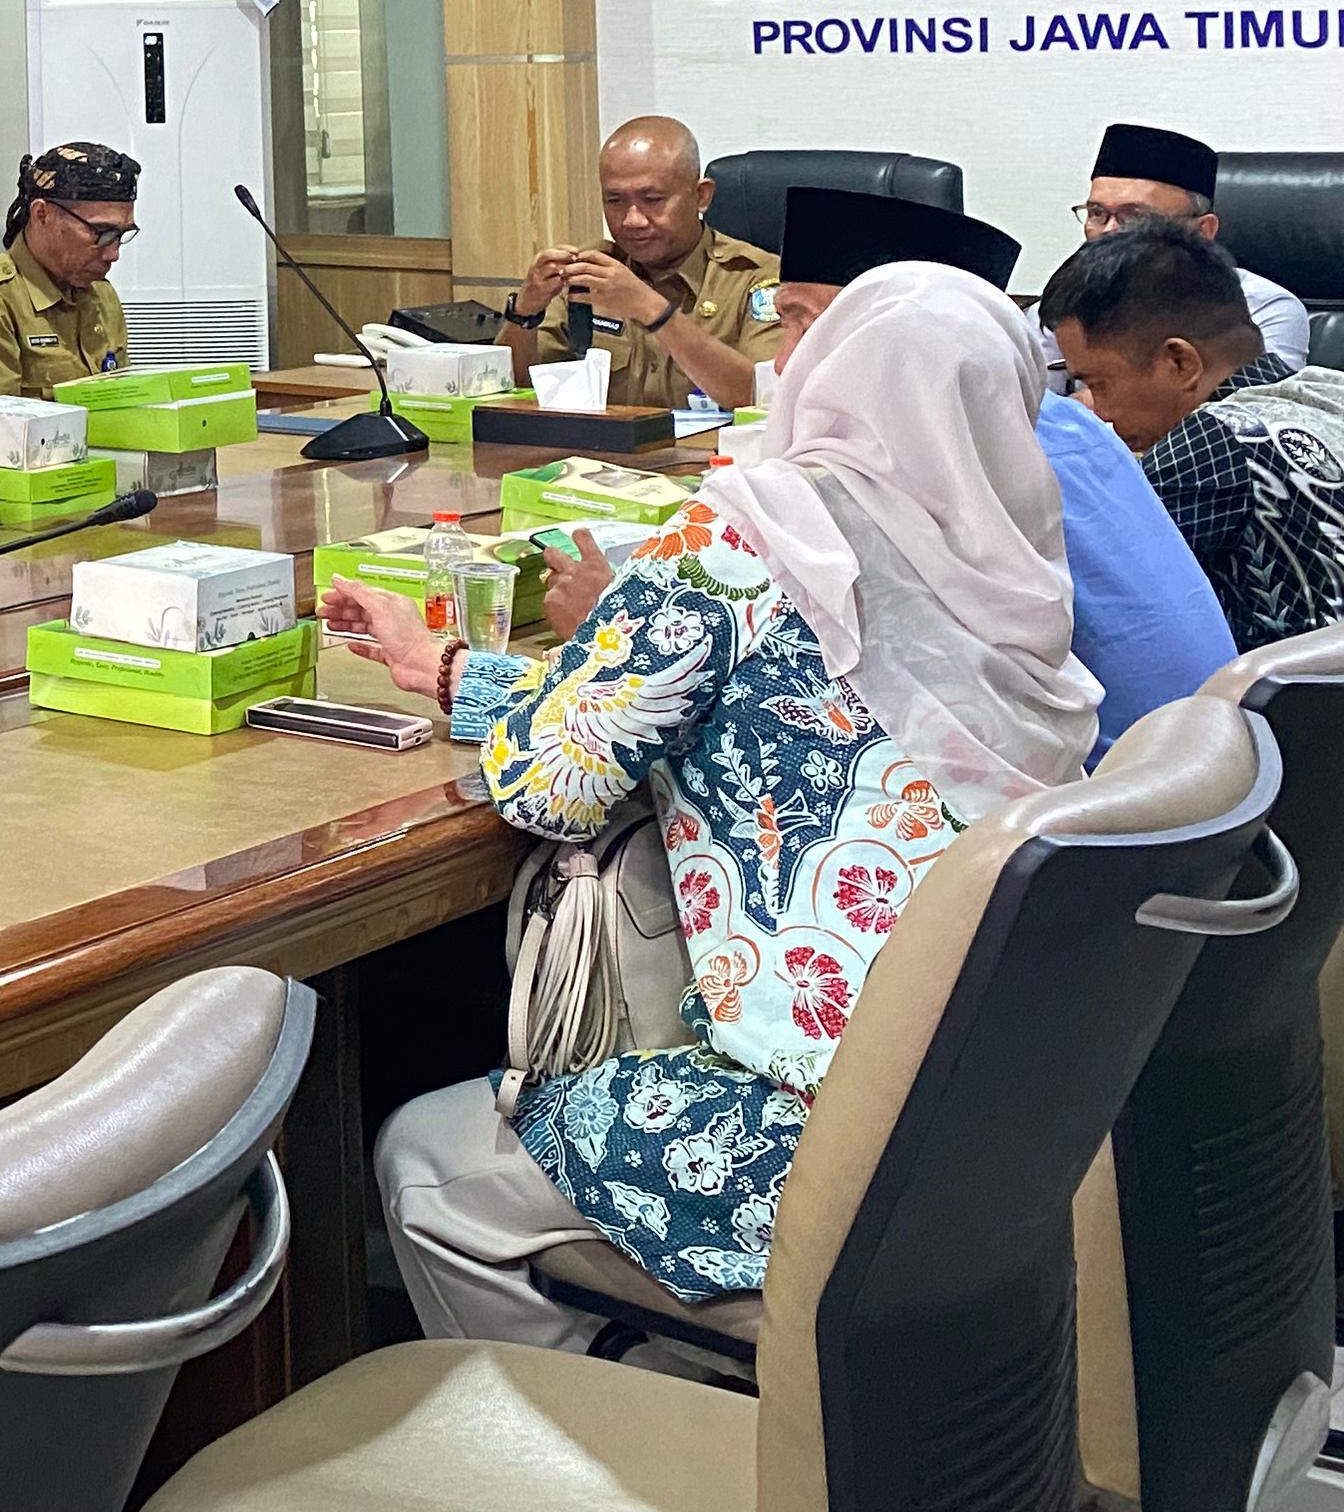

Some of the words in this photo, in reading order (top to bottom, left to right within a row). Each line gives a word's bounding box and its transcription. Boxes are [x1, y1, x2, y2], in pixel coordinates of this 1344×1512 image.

[753, 17, 989, 55] PROVINSI
[1009, 13, 1169, 51] JAWA
[1184, 9, 1344, 49] TIMU
